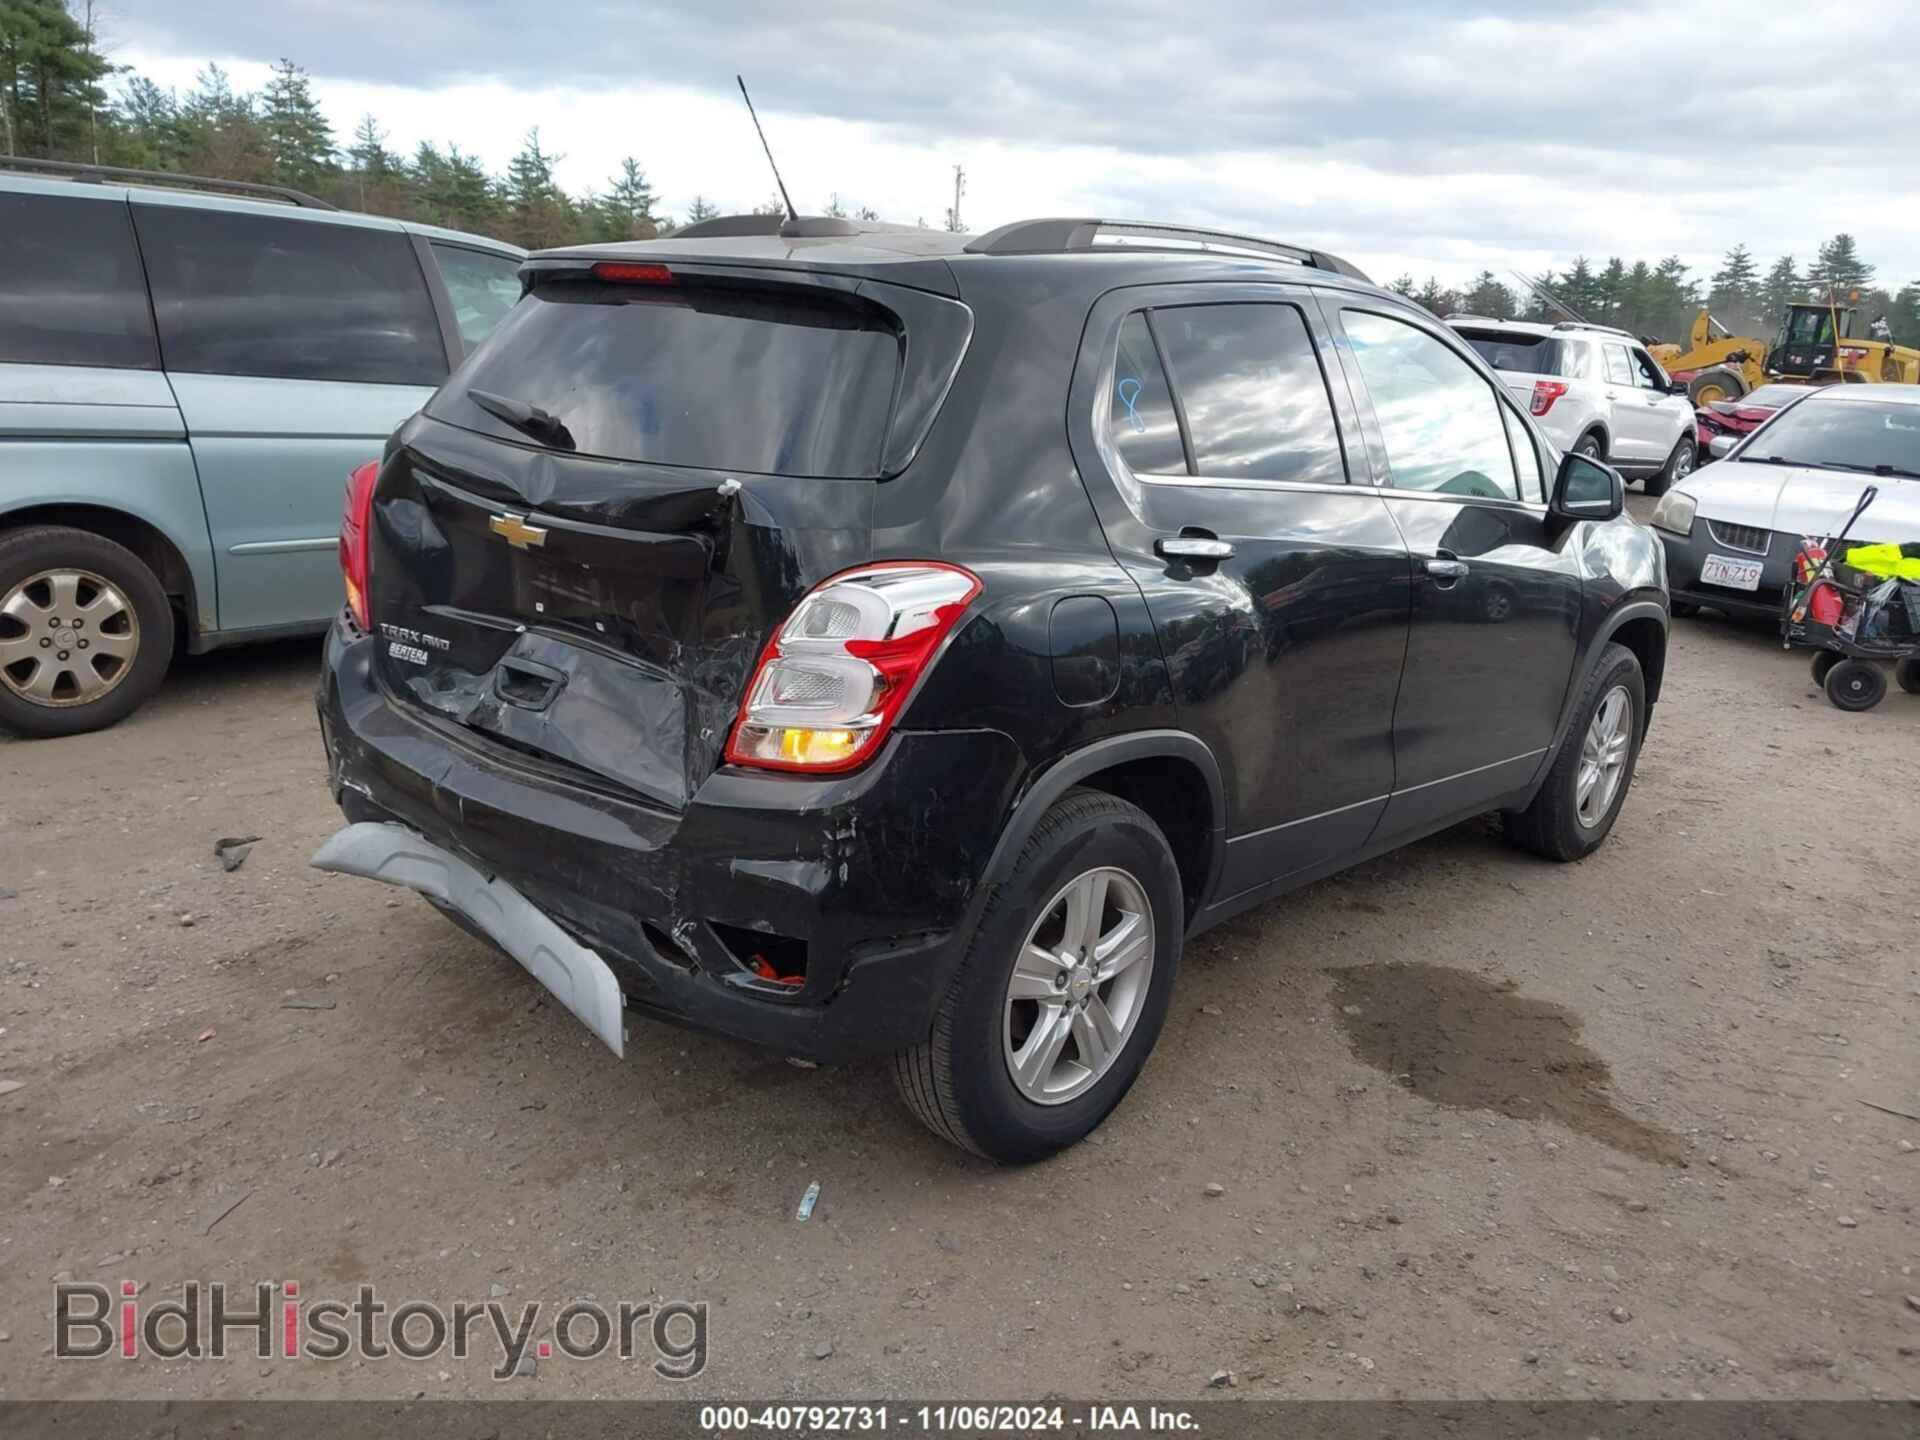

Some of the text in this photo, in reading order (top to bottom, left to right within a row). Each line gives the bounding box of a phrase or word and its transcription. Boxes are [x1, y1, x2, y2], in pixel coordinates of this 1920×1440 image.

[380, 623, 450, 650] TRAX AWD
[389, 642, 428, 662] BERTERA
